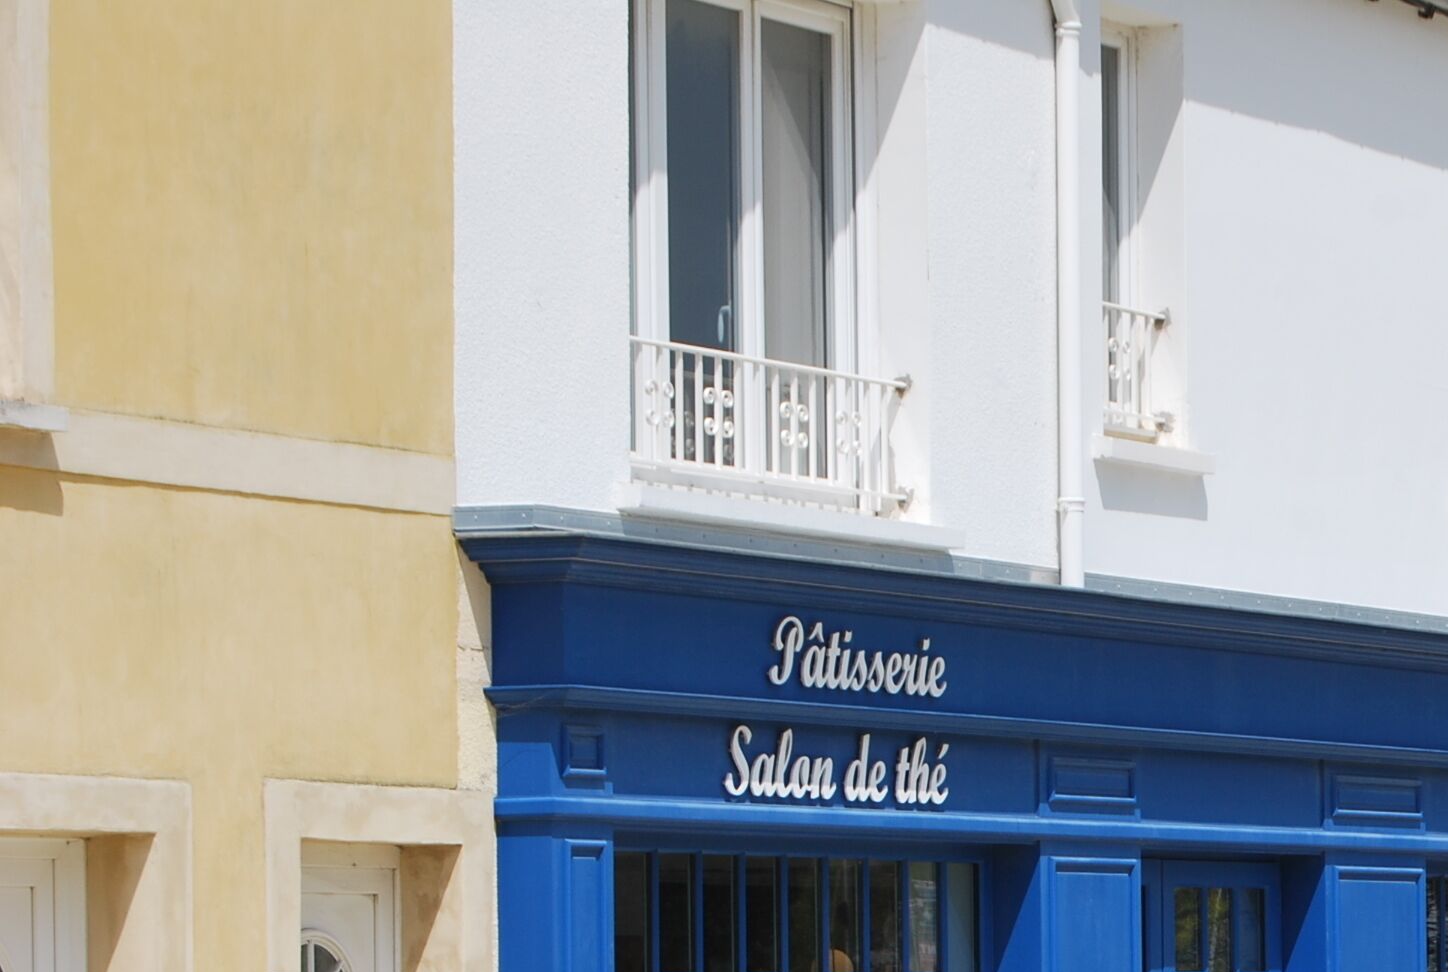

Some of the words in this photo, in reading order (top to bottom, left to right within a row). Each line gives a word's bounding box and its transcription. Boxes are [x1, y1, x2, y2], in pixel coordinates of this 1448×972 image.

[768, 615, 947, 698] Pâtisserie
[724, 724, 837, 800] Salon
[844, 733, 888, 802] de
[895, 737, 949, 804] thé
